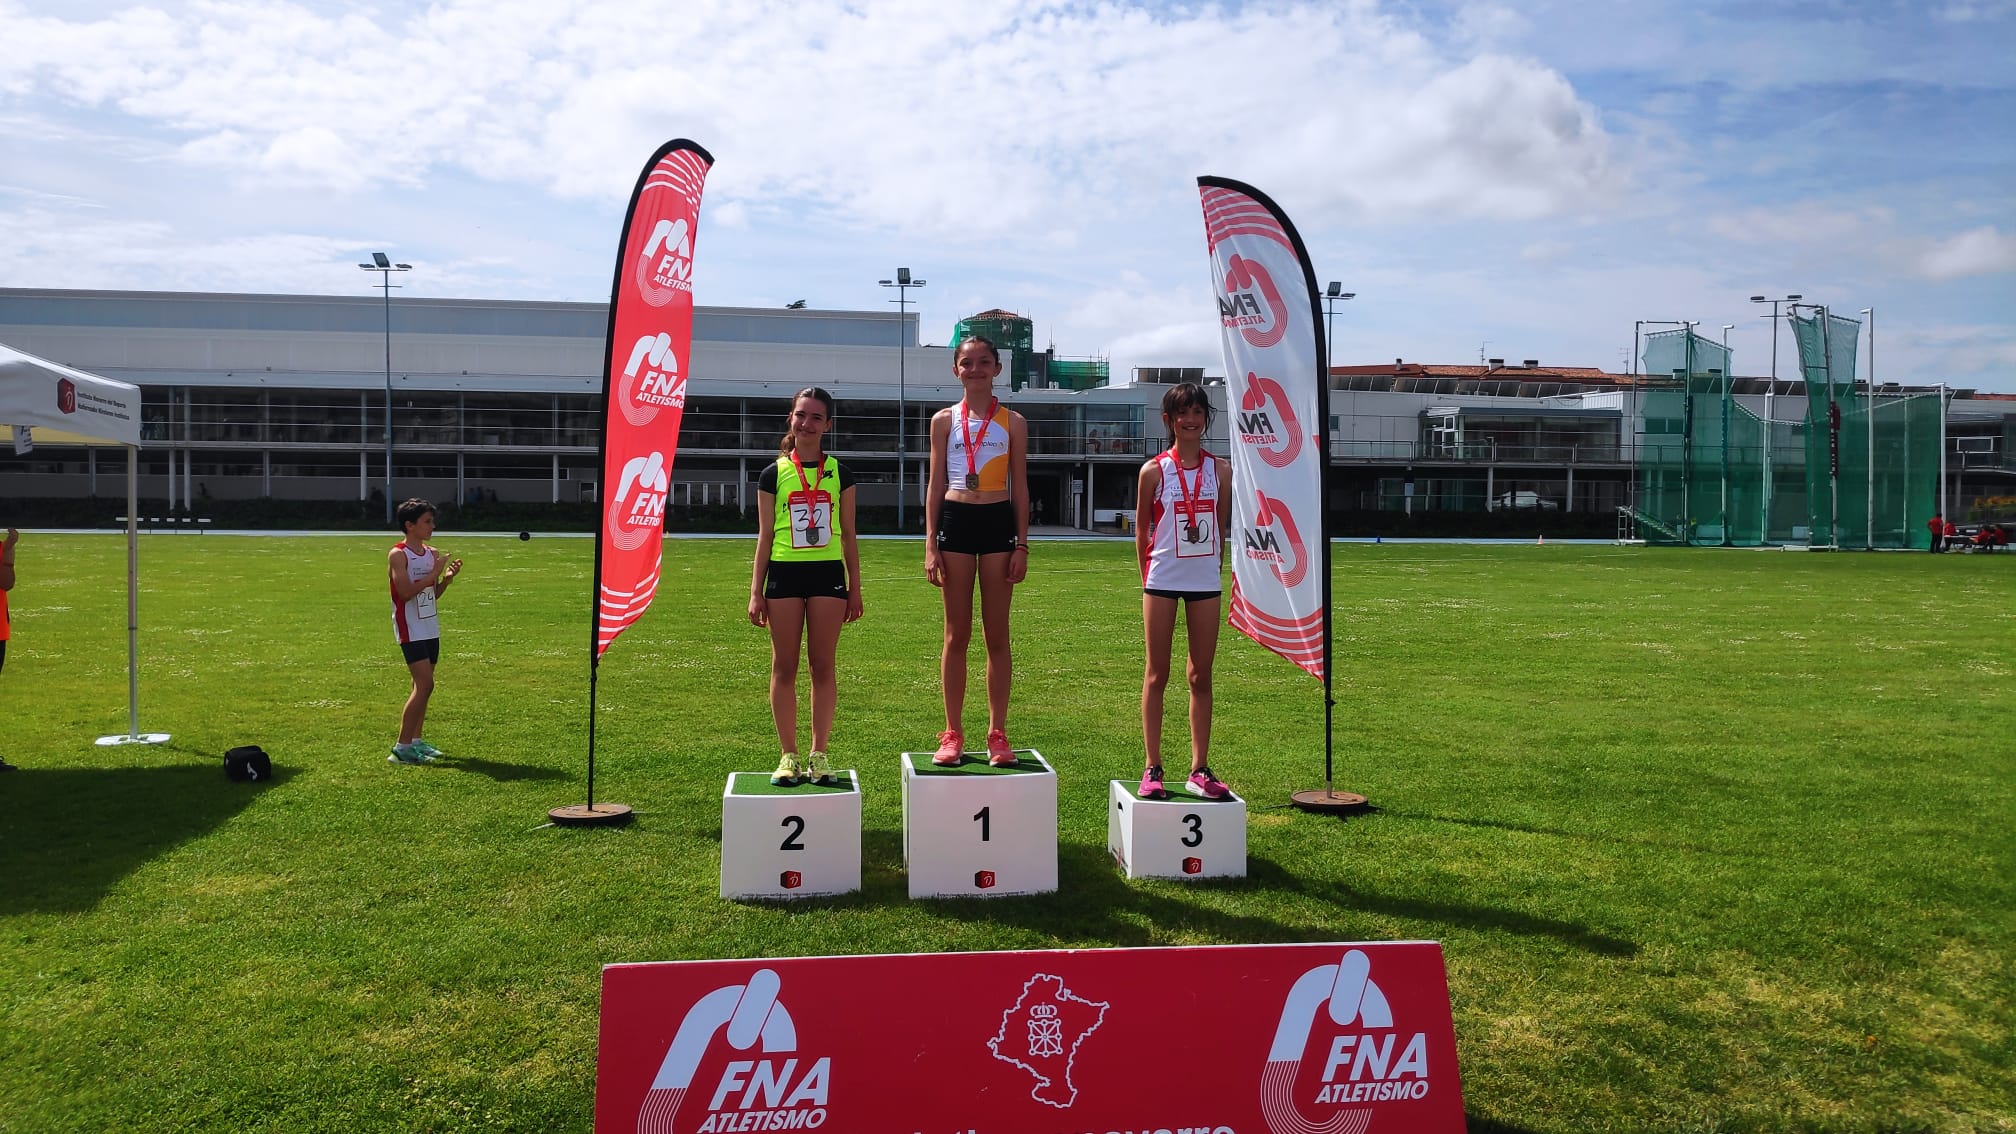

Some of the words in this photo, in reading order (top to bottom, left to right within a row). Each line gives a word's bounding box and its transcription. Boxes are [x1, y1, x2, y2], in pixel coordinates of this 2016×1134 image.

[657, 254, 692, 283] FN
[640, 370, 687, 400] FNA
[635, 391, 685, 409] ATLETISMO
[631, 492, 667, 517] FN
[794, 508, 825, 532] 32
[780, 815, 805, 850] 2
[973, 806, 990, 841] 1
[1181, 813, 1203, 847] 3
[1321, 1032, 1428, 1082] FNA
[707, 1057, 831, 1111] FNA
[1314, 1080, 1429, 1104] ATLETISMO
[696, 1108, 827, 1134] ATLETISMO
